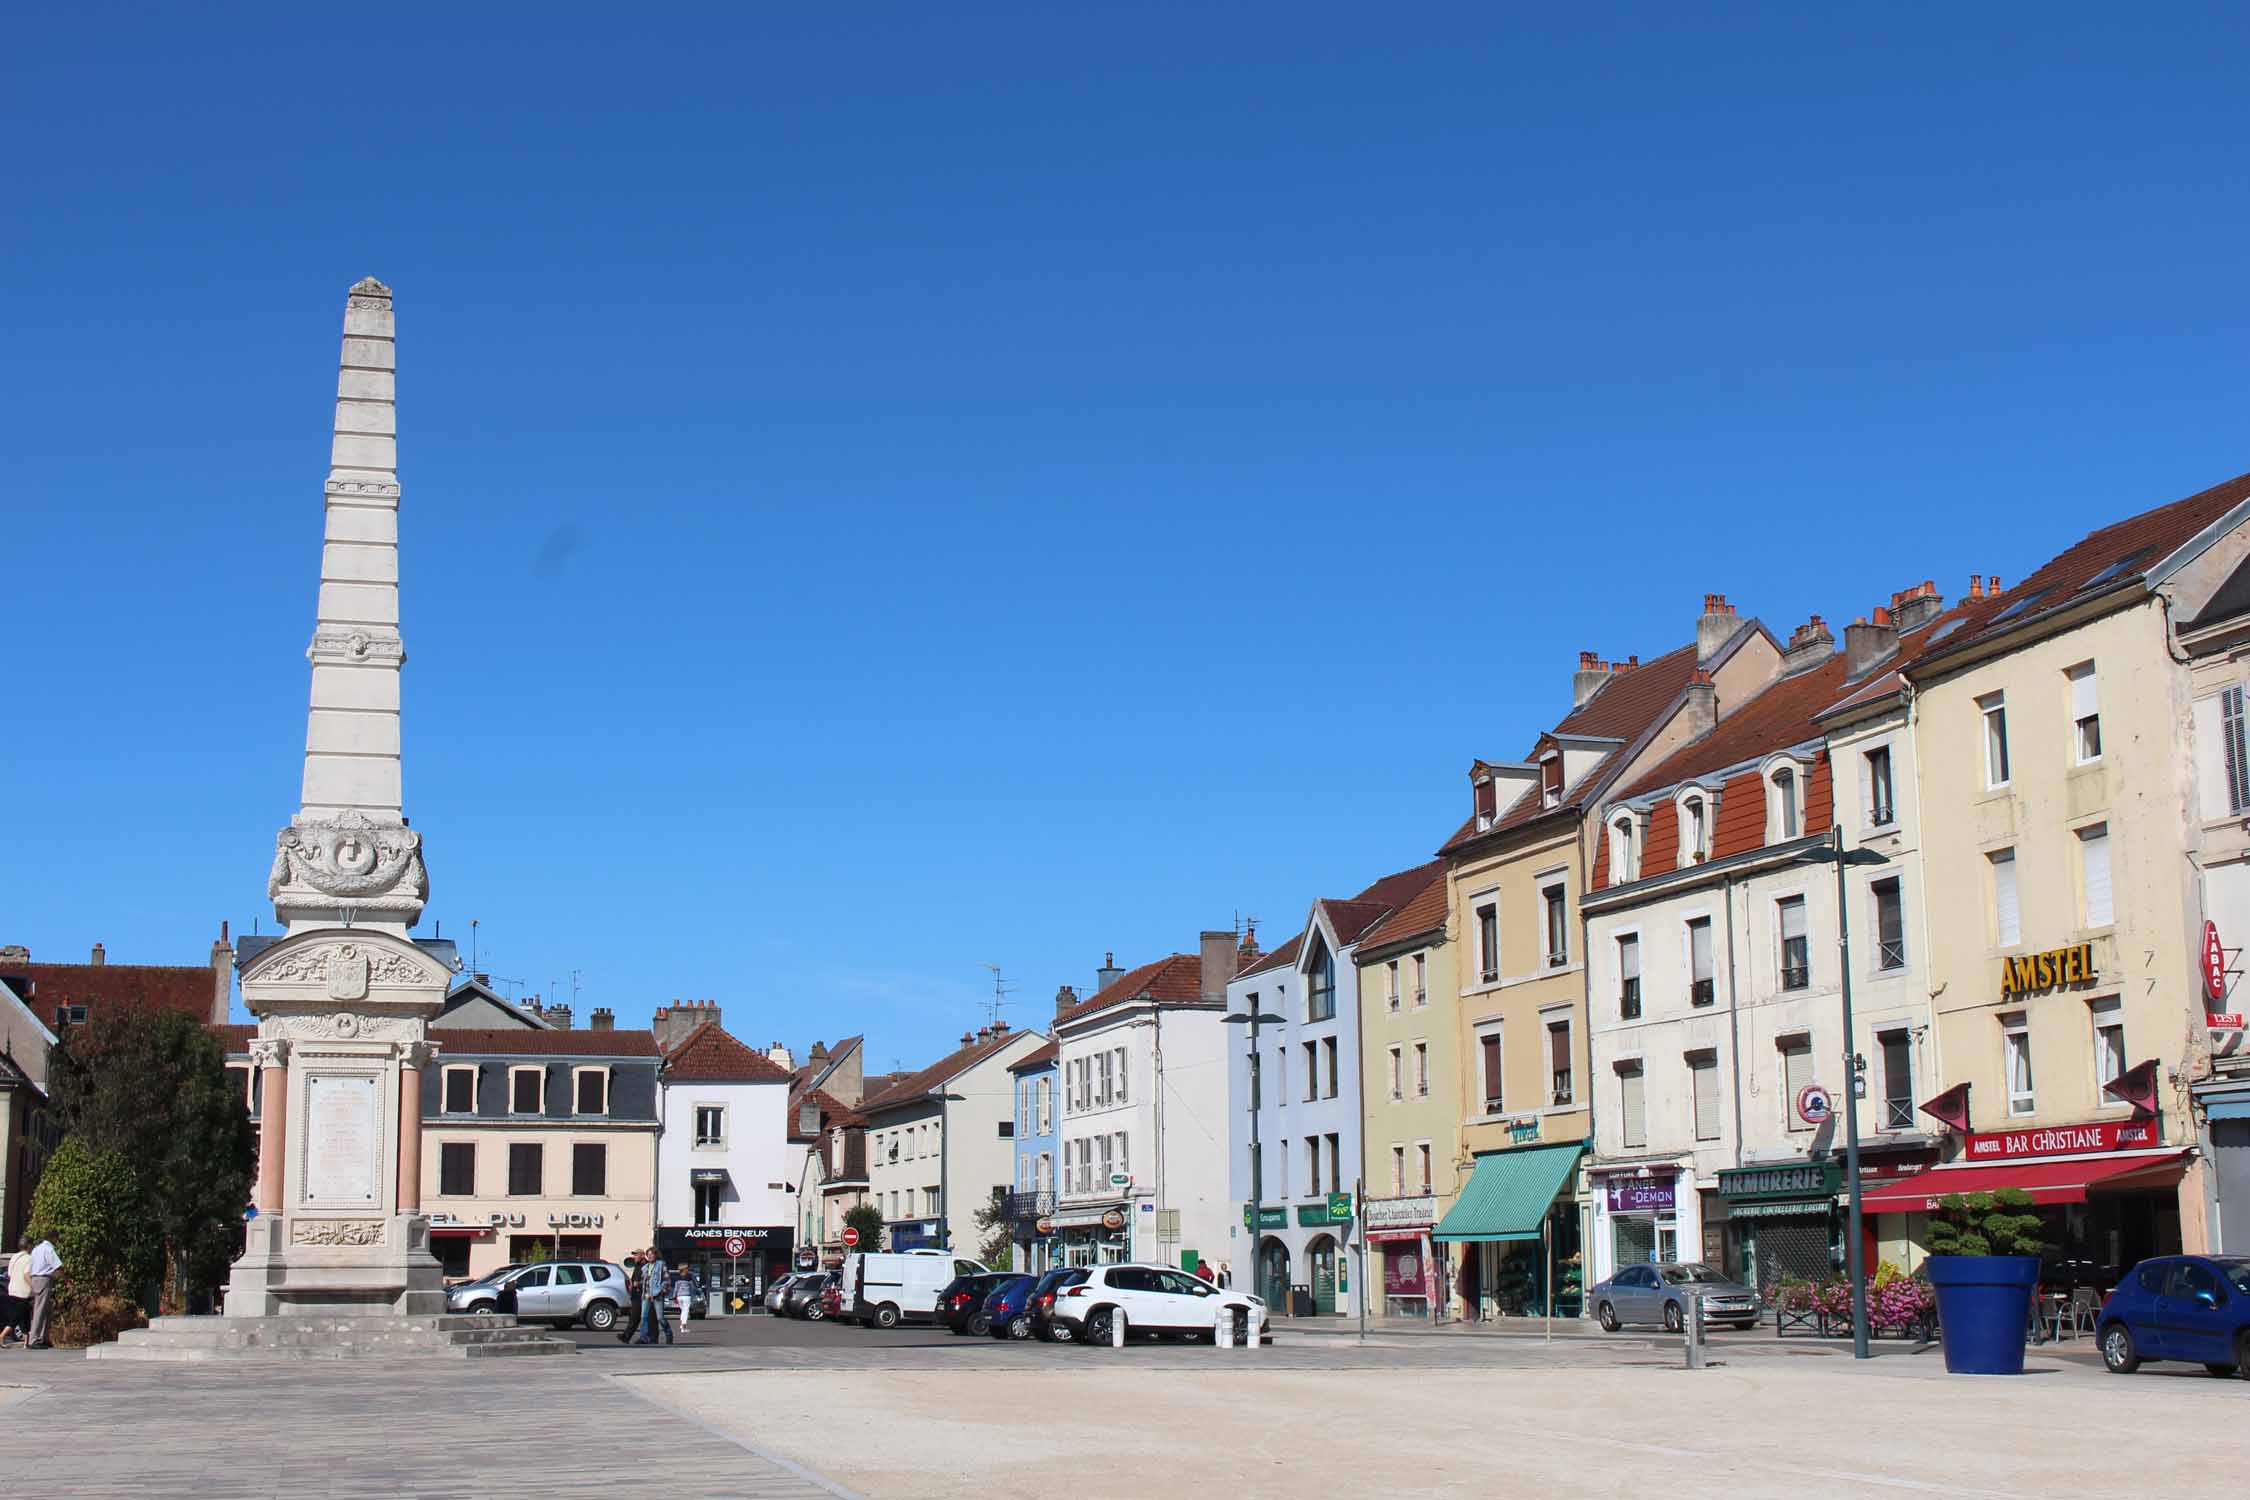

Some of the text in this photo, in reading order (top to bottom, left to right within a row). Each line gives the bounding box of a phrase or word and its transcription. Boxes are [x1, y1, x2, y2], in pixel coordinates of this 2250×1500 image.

[2001, 943, 2092, 994] AMSTEL
[2209, 931, 2221, 988] TABAC
[2006, 1136, 2028, 1153] BAR
[2032, 1128, 2102, 1151] CHRISTIANE
[1721, 1168, 1823, 1194] ARMURERIE
[1636, 1190, 1672, 1203] DÉMON
[489, 1212, 525, 1227] DU
[547, 1212, 603, 1228] LION
[685, 1229, 768, 1238] AGNÈS BENEUX
